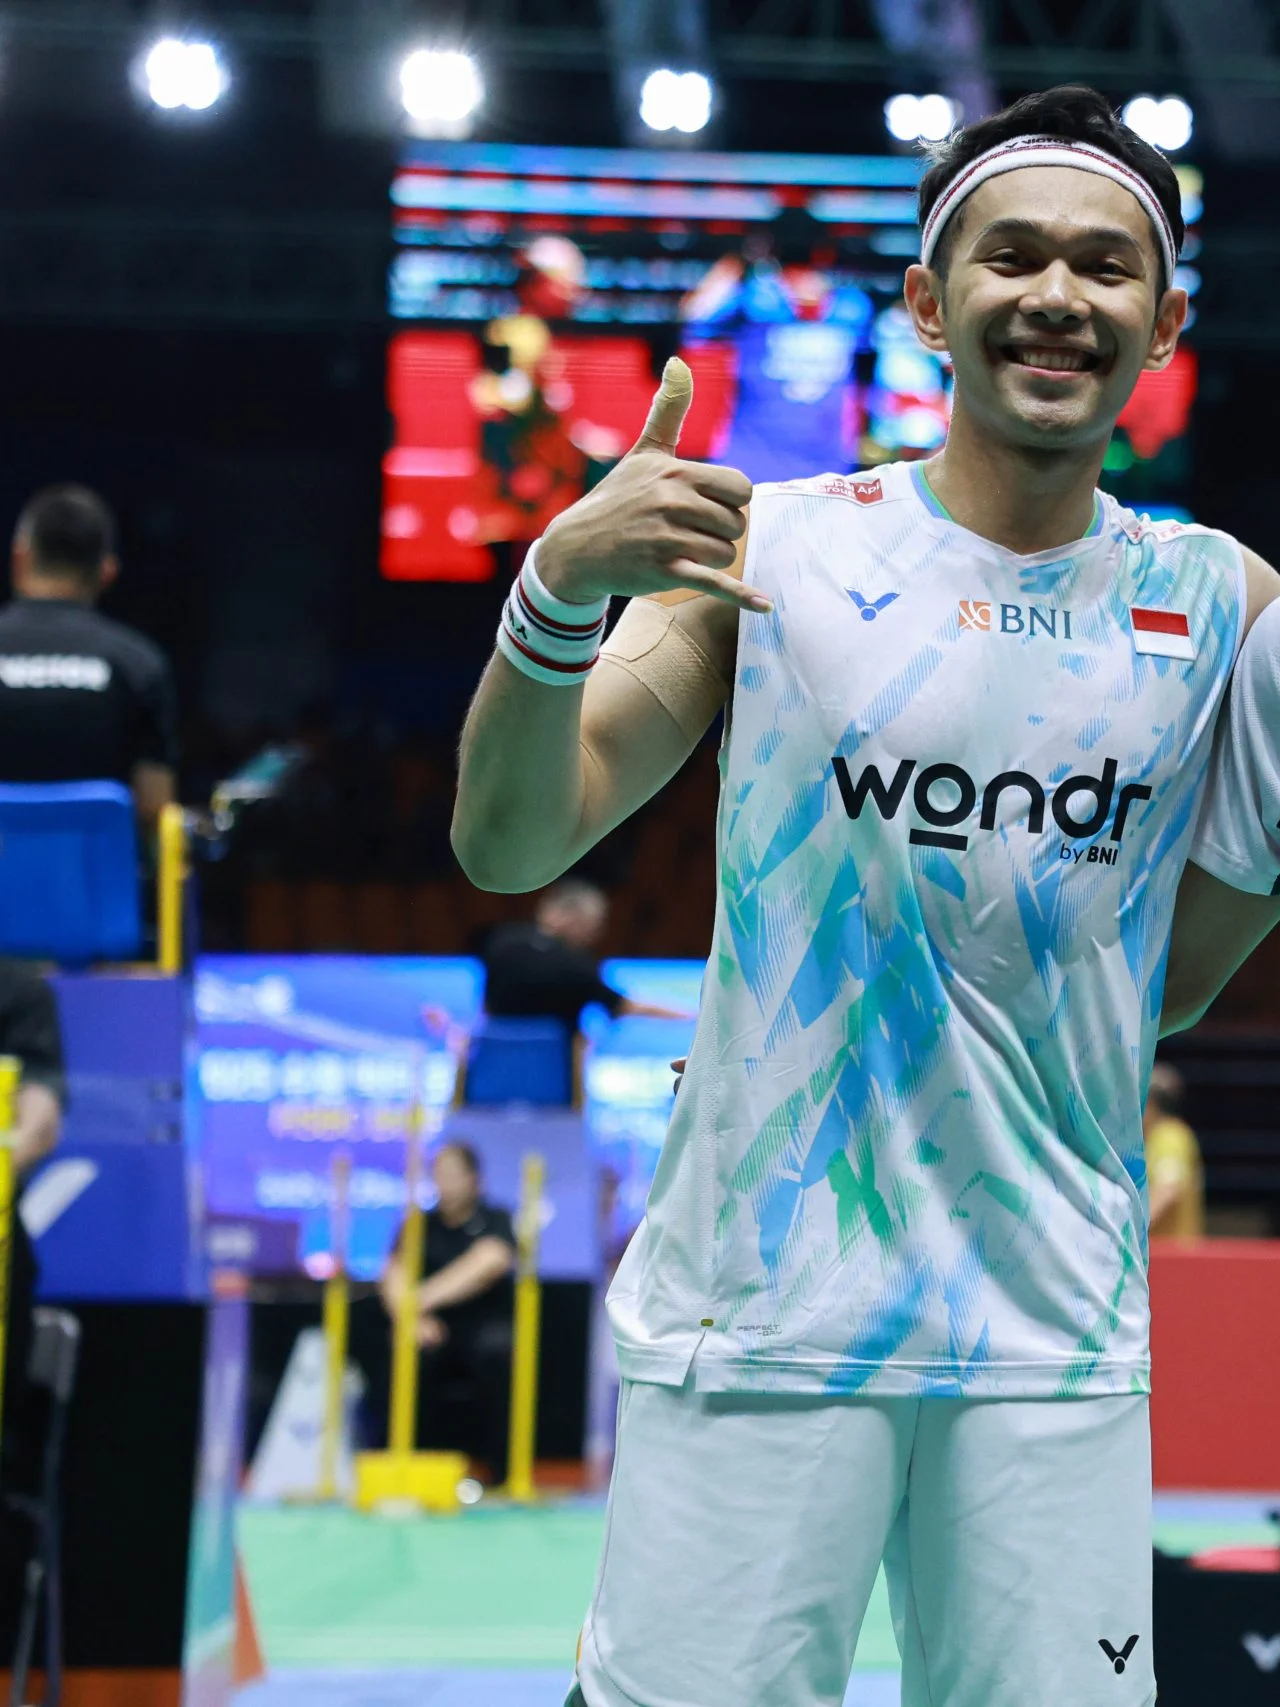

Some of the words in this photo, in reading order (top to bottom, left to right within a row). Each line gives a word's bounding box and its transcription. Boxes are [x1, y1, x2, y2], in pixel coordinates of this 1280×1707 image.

[857, 482, 880, 495] Api
[999, 603, 1072, 640] BNI
[831, 757, 1152, 846] wondr
[1060, 842, 1085, 865] by
[1087, 845, 1119, 866] BNI
